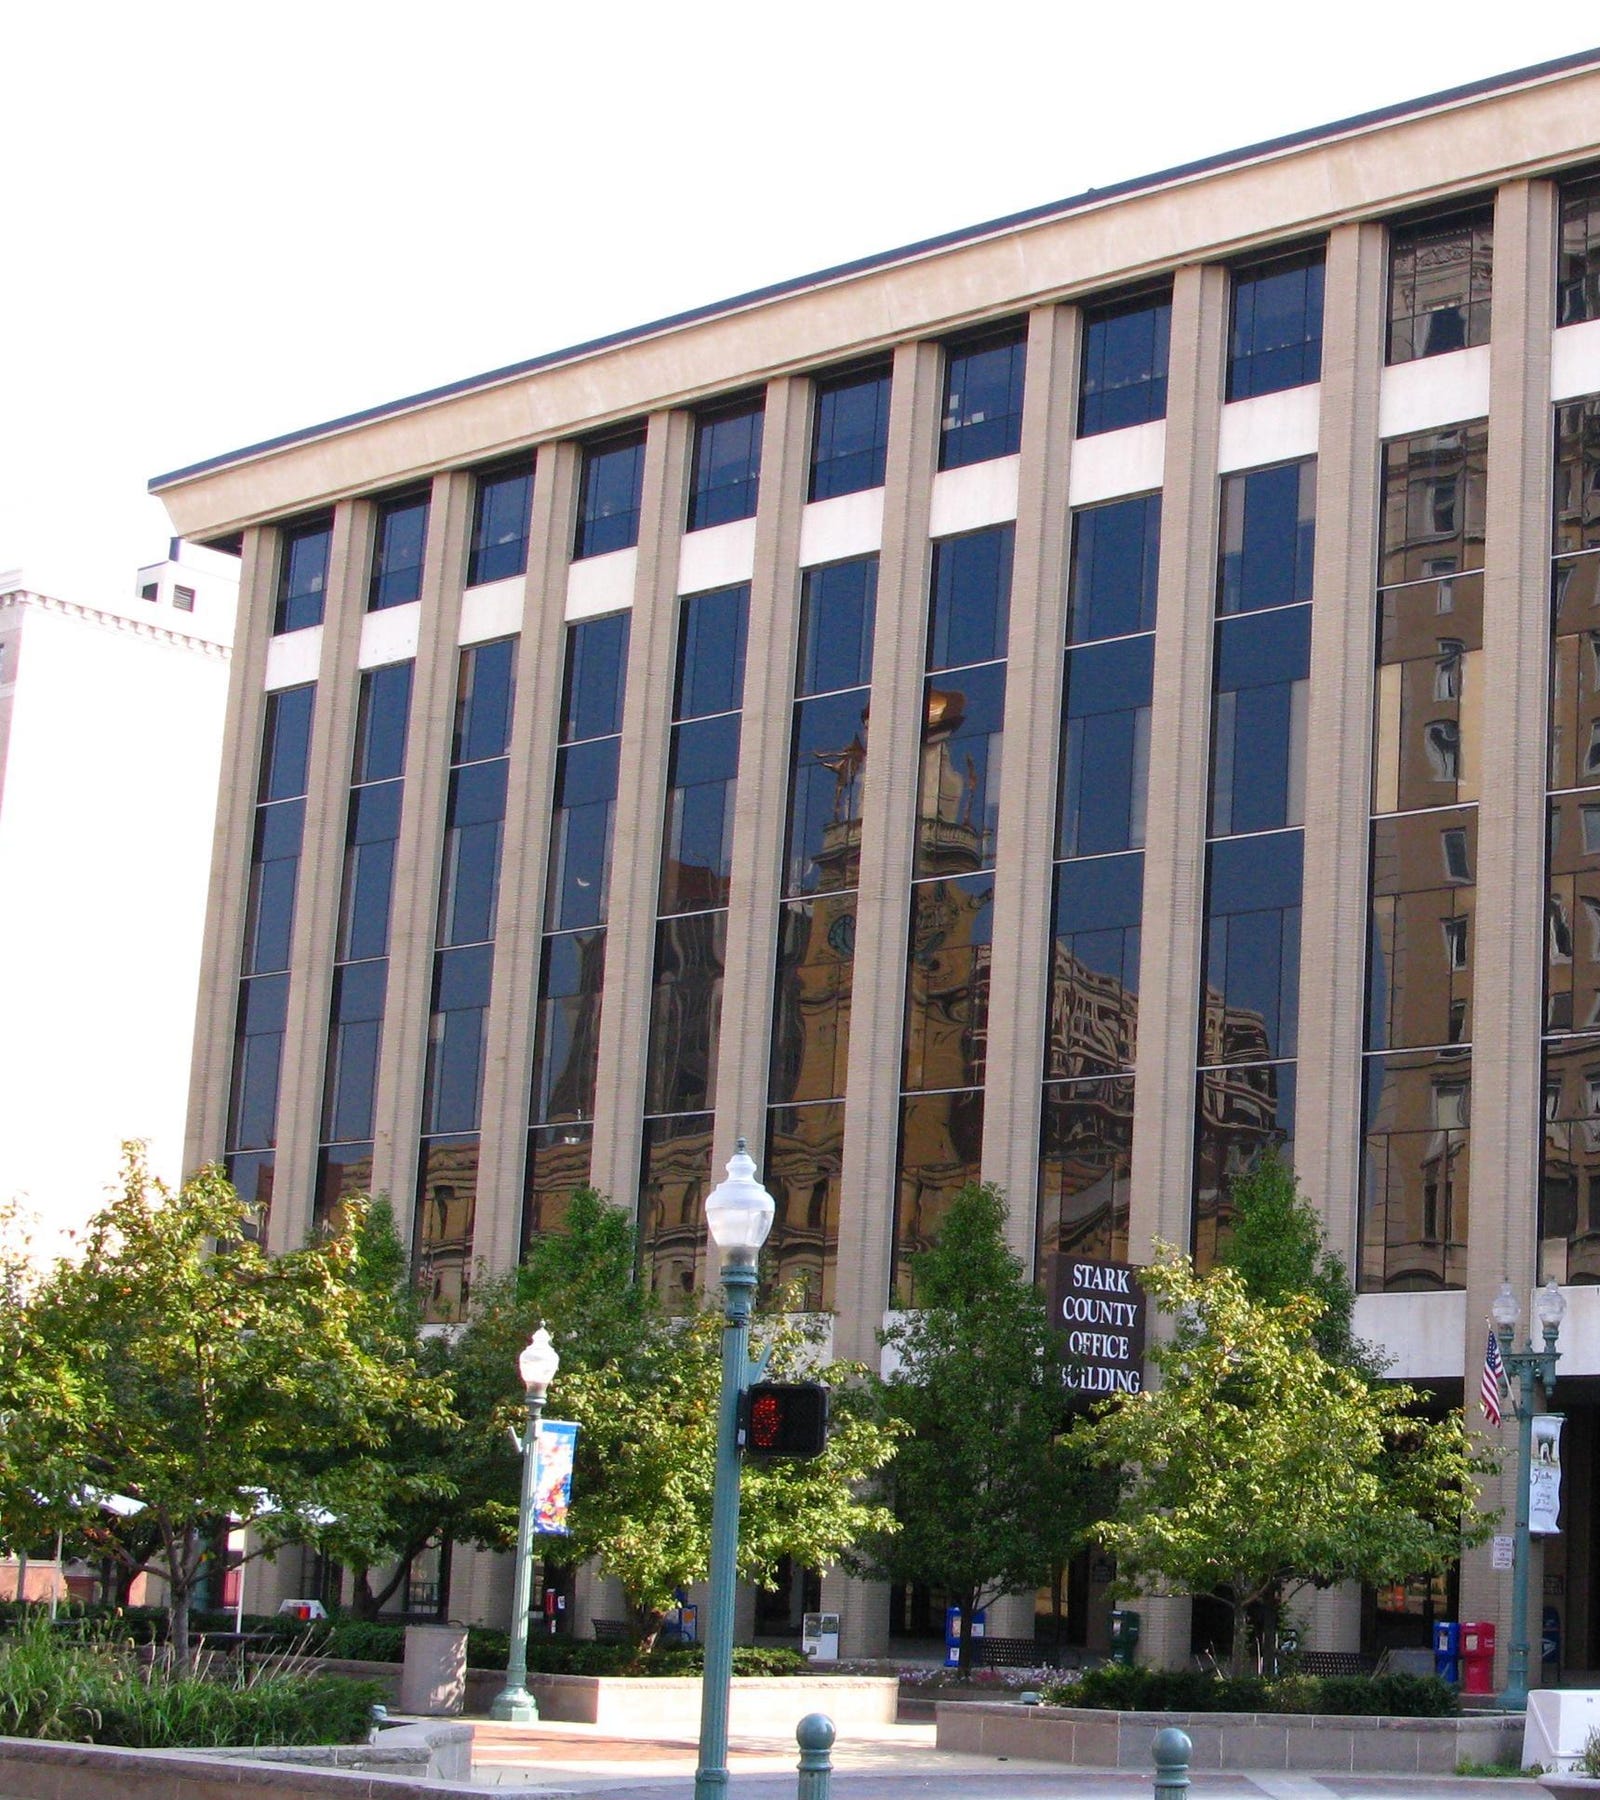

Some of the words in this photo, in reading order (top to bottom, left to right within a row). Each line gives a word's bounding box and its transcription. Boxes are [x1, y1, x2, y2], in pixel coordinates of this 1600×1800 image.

[1073, 1263, 1130, 1293] STARK
[1063, 1296, 1137, 1327] COUNTY
[1069, 1331, 1129, 1359] OFFICE
